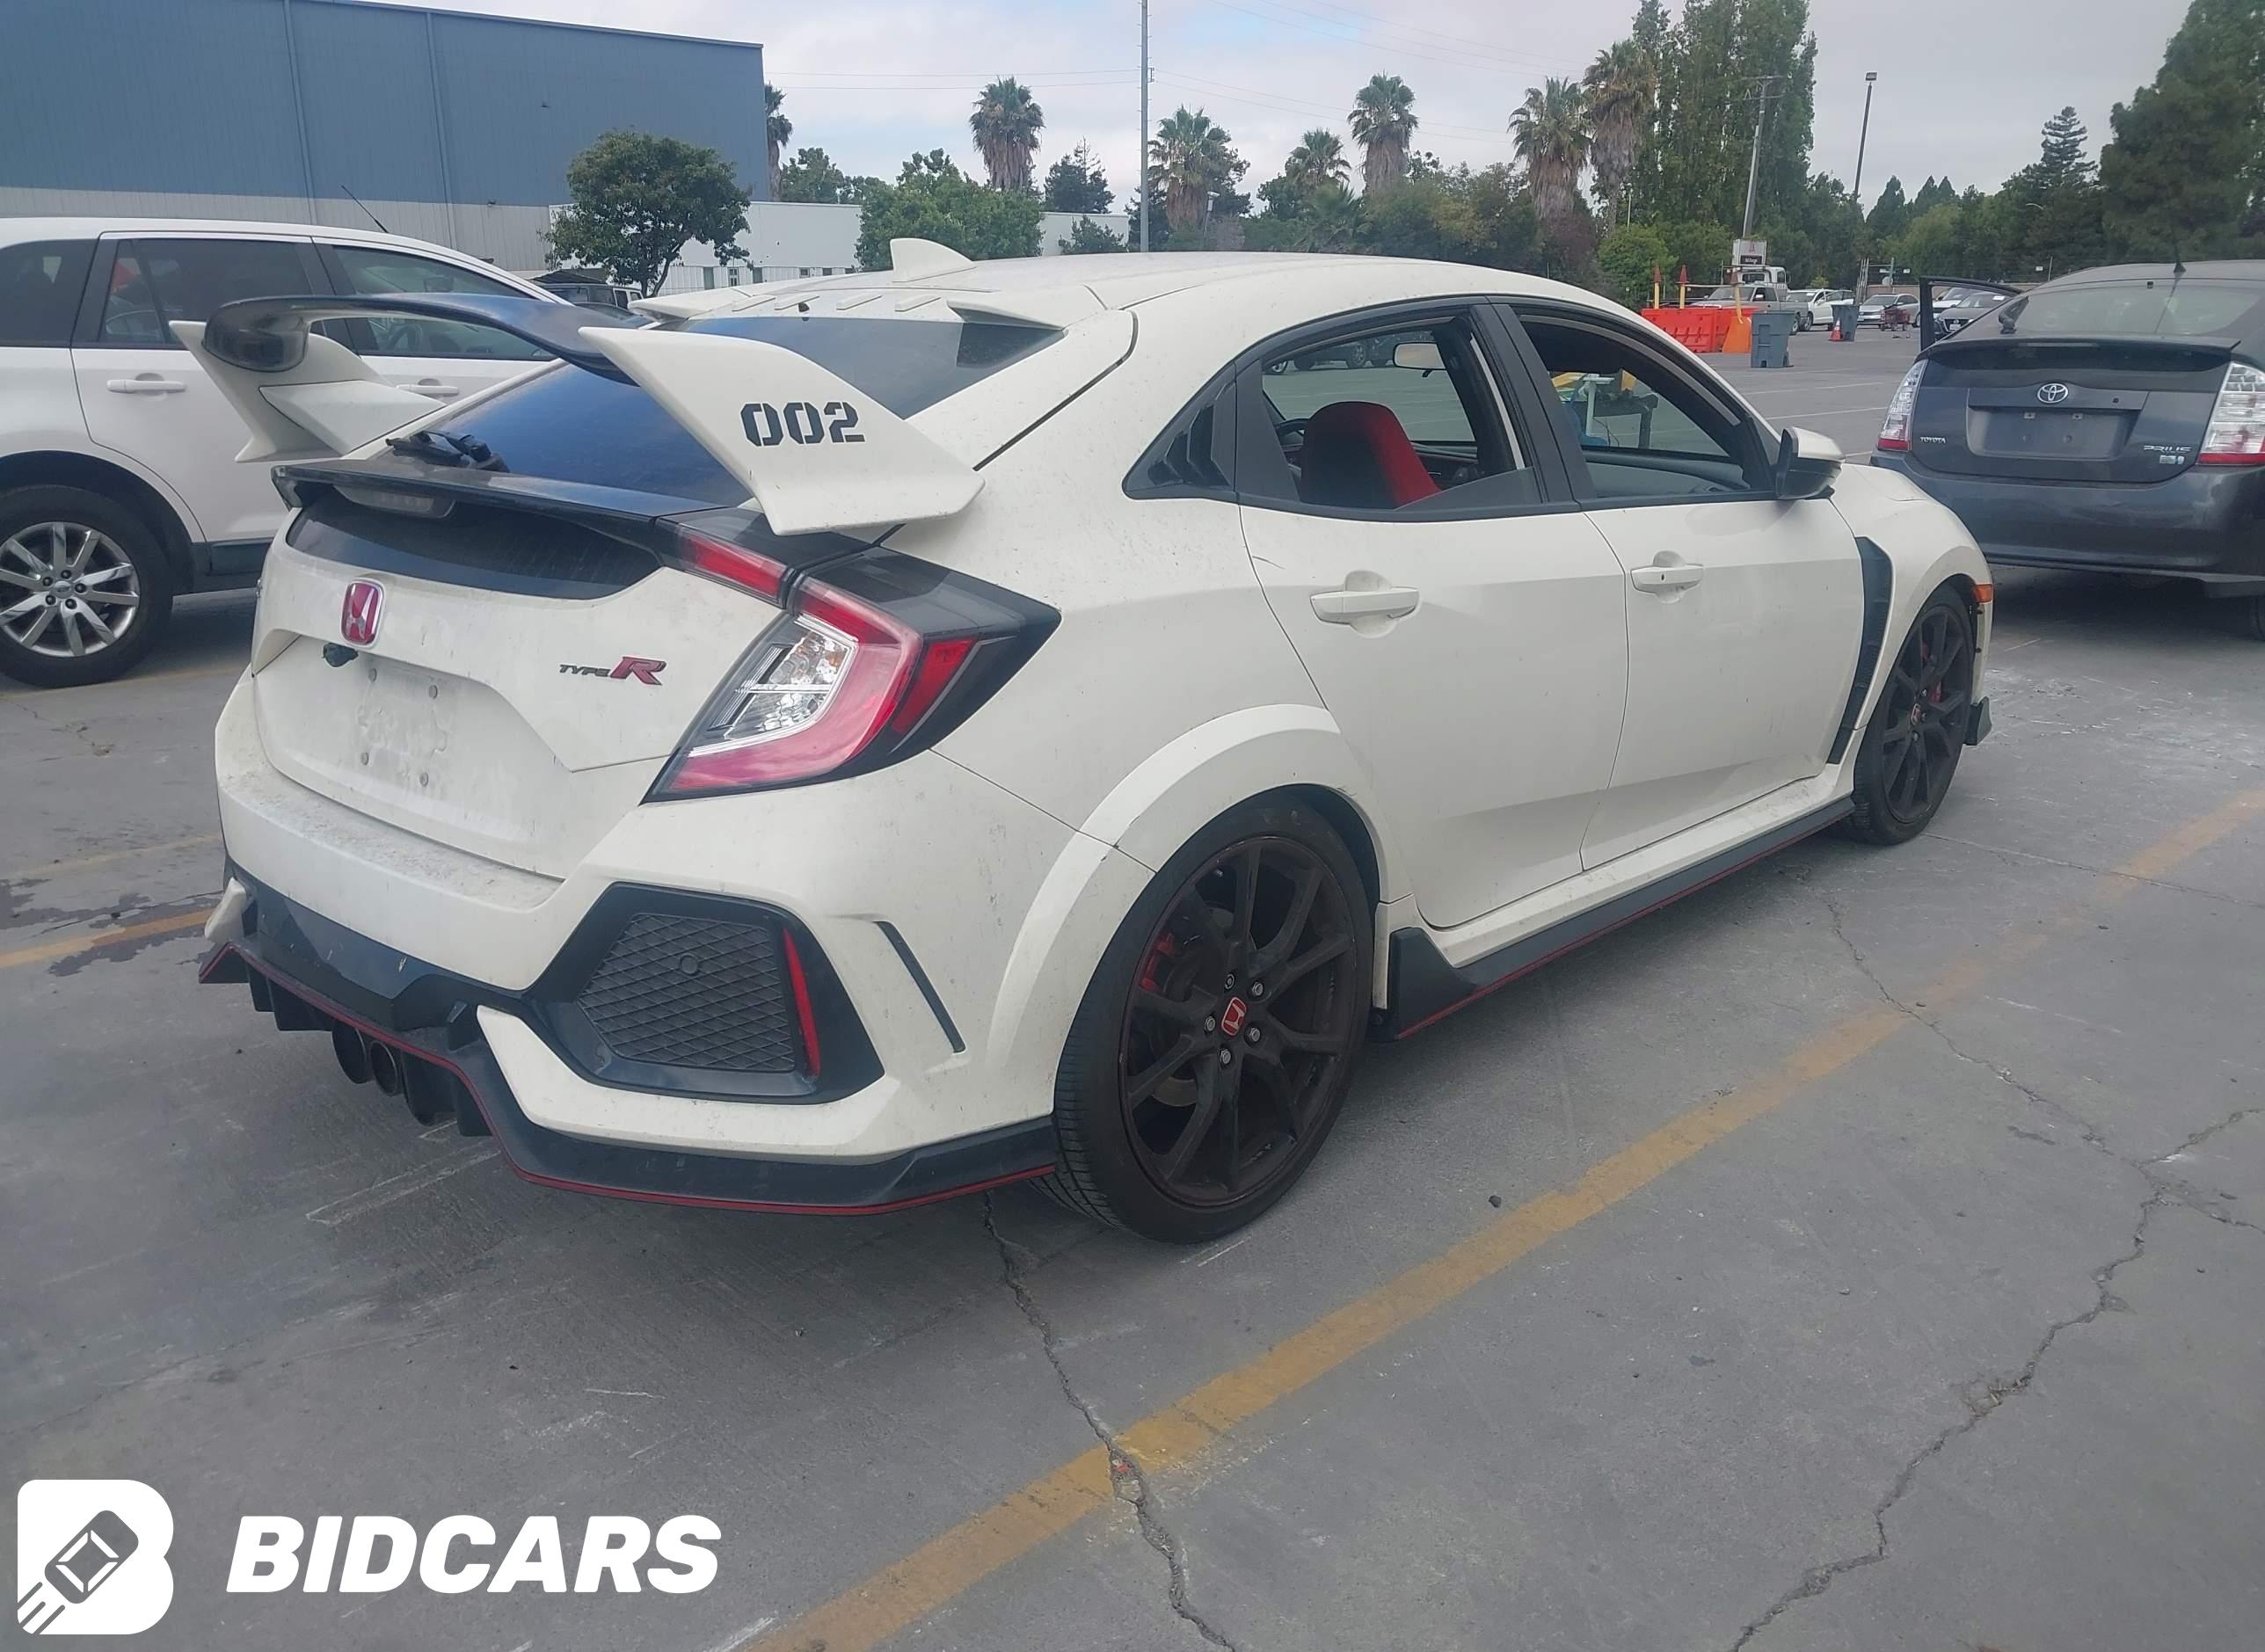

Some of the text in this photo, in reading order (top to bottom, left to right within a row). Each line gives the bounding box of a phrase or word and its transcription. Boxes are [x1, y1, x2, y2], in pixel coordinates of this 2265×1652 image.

[740, 402, 866, 447] 002
[559, 656, 666, 686] TYPE R
